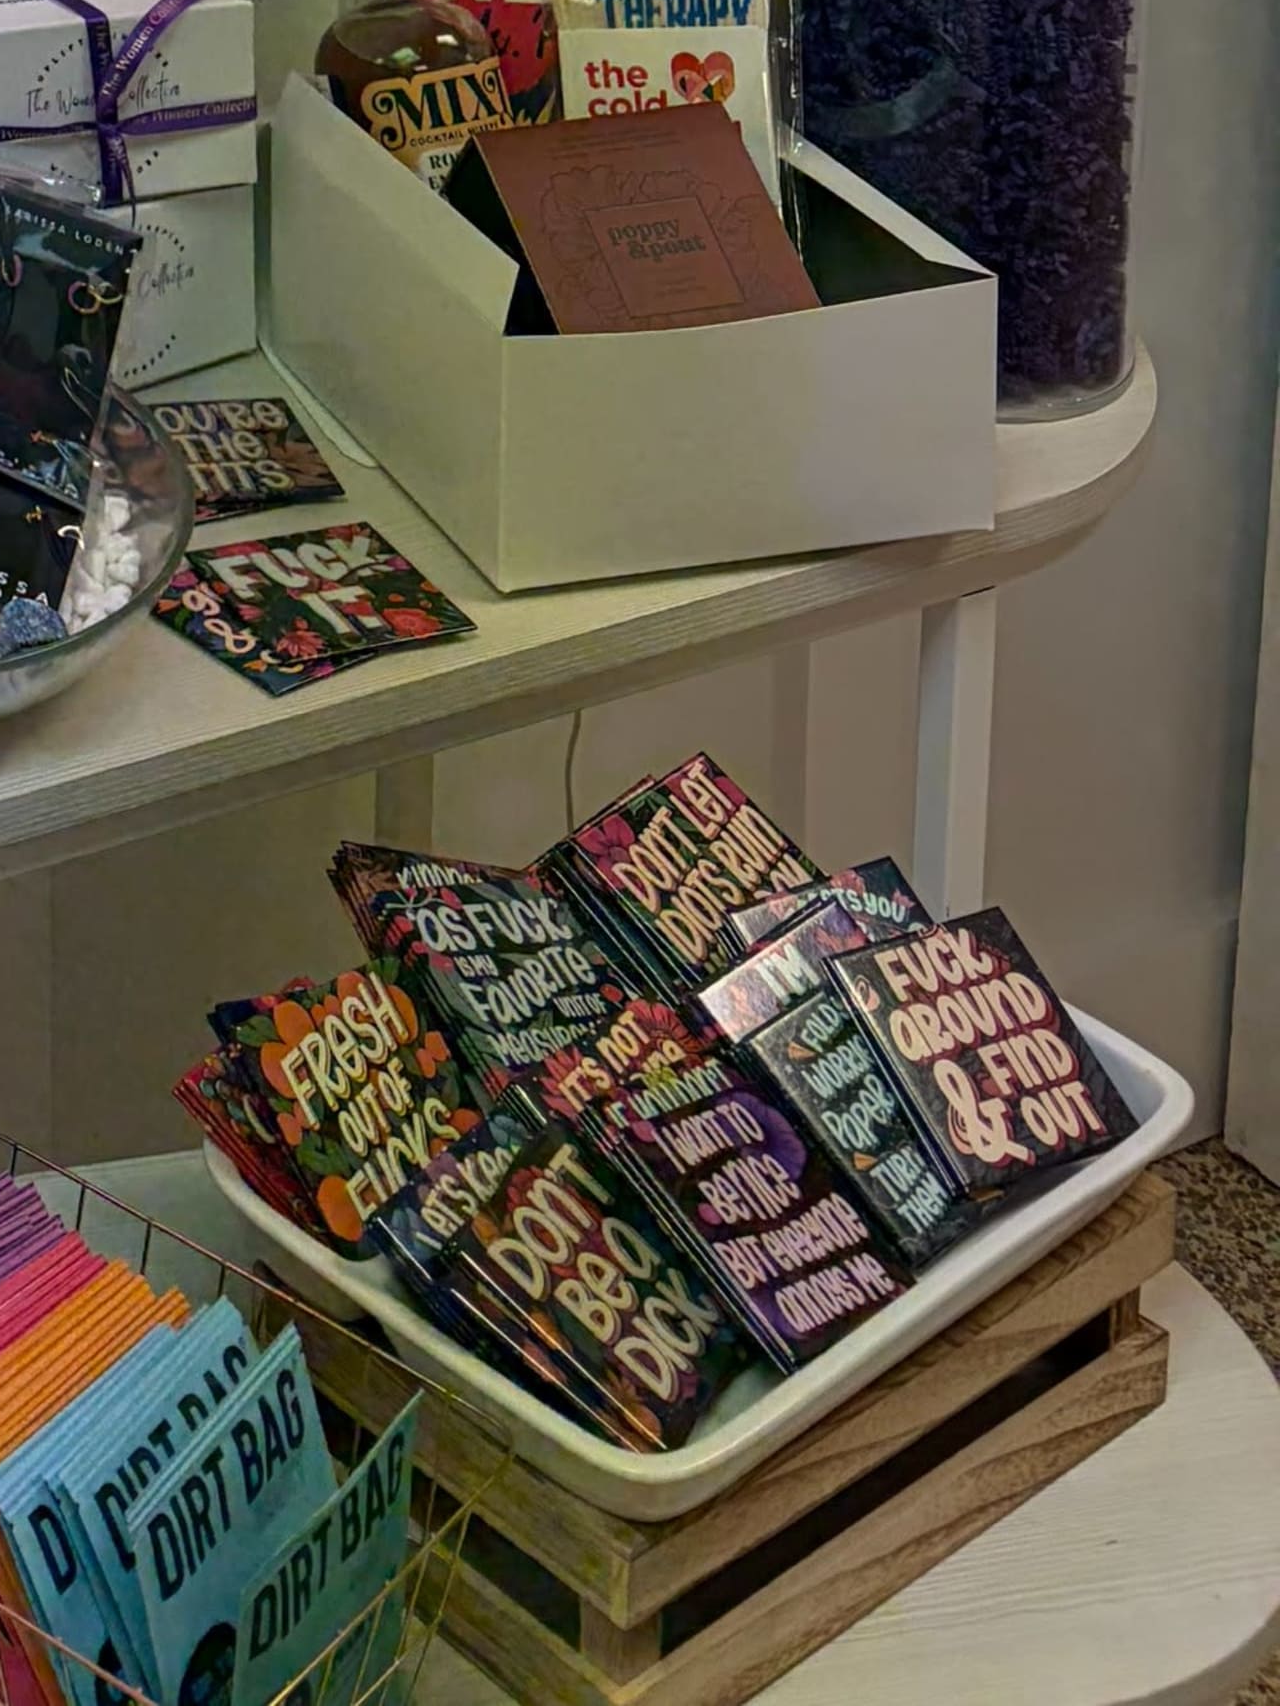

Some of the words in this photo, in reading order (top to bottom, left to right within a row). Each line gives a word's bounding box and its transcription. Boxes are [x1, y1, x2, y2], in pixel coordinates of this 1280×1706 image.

[115, 25, 156, 75] Women
[583, 58, 649, 89] the
[26, 89, 51, 120] The
[128, 71, 181, 112] ollective
[586, 89, 669, 118] cold
[409, 130, 464, 148] COCKTAIL
[73, 230, 125, 257] LODEN
[607, 217, 680, 245] poppy
[156, 398, 289, 435] OU'RE
[169, 429, 270, 465] THE
[206, 535, 394, 600] FUCK
[302, 585, 386, 636] IT
[611, 805, 700, 917] DON'T
[669, 760, 738, 842] LET
[654, 857, 740, 965] IDIOTS
[708, 803, 790, 893] RUIN
[862, 891, 907, 924] YOU
[758, 942, 821, 1003] I'M
[873, 925, 996, 1005] FUCK
[279, 970, 412, 1131] FRESH
[887, 971, 1052, 1062] AROUND
[556, 1056, 614, 1114] IT'S
[595, 1008, 651, 1075] NOT
[977, 1027, 1075, 1096] FIND
[337, 1089, 390, 1159] OUT
[377, 1055, 414, 1119] OF
[931, 1055, 1034, 1167] &
[1020, 1080, 1104, 1149] OUT
[486, 1142, 616, 1301] DON'T
[554, 1249, 641, 1345] BE
[612, 1269, 721, 1404] DICK
[146, 1446, 232, 1603] DIRT
[231, 1367, 307, 1507] BAG
[248, 1516, 334, 1663] DIRT
[338, 1430, 408, 1565] BAG
